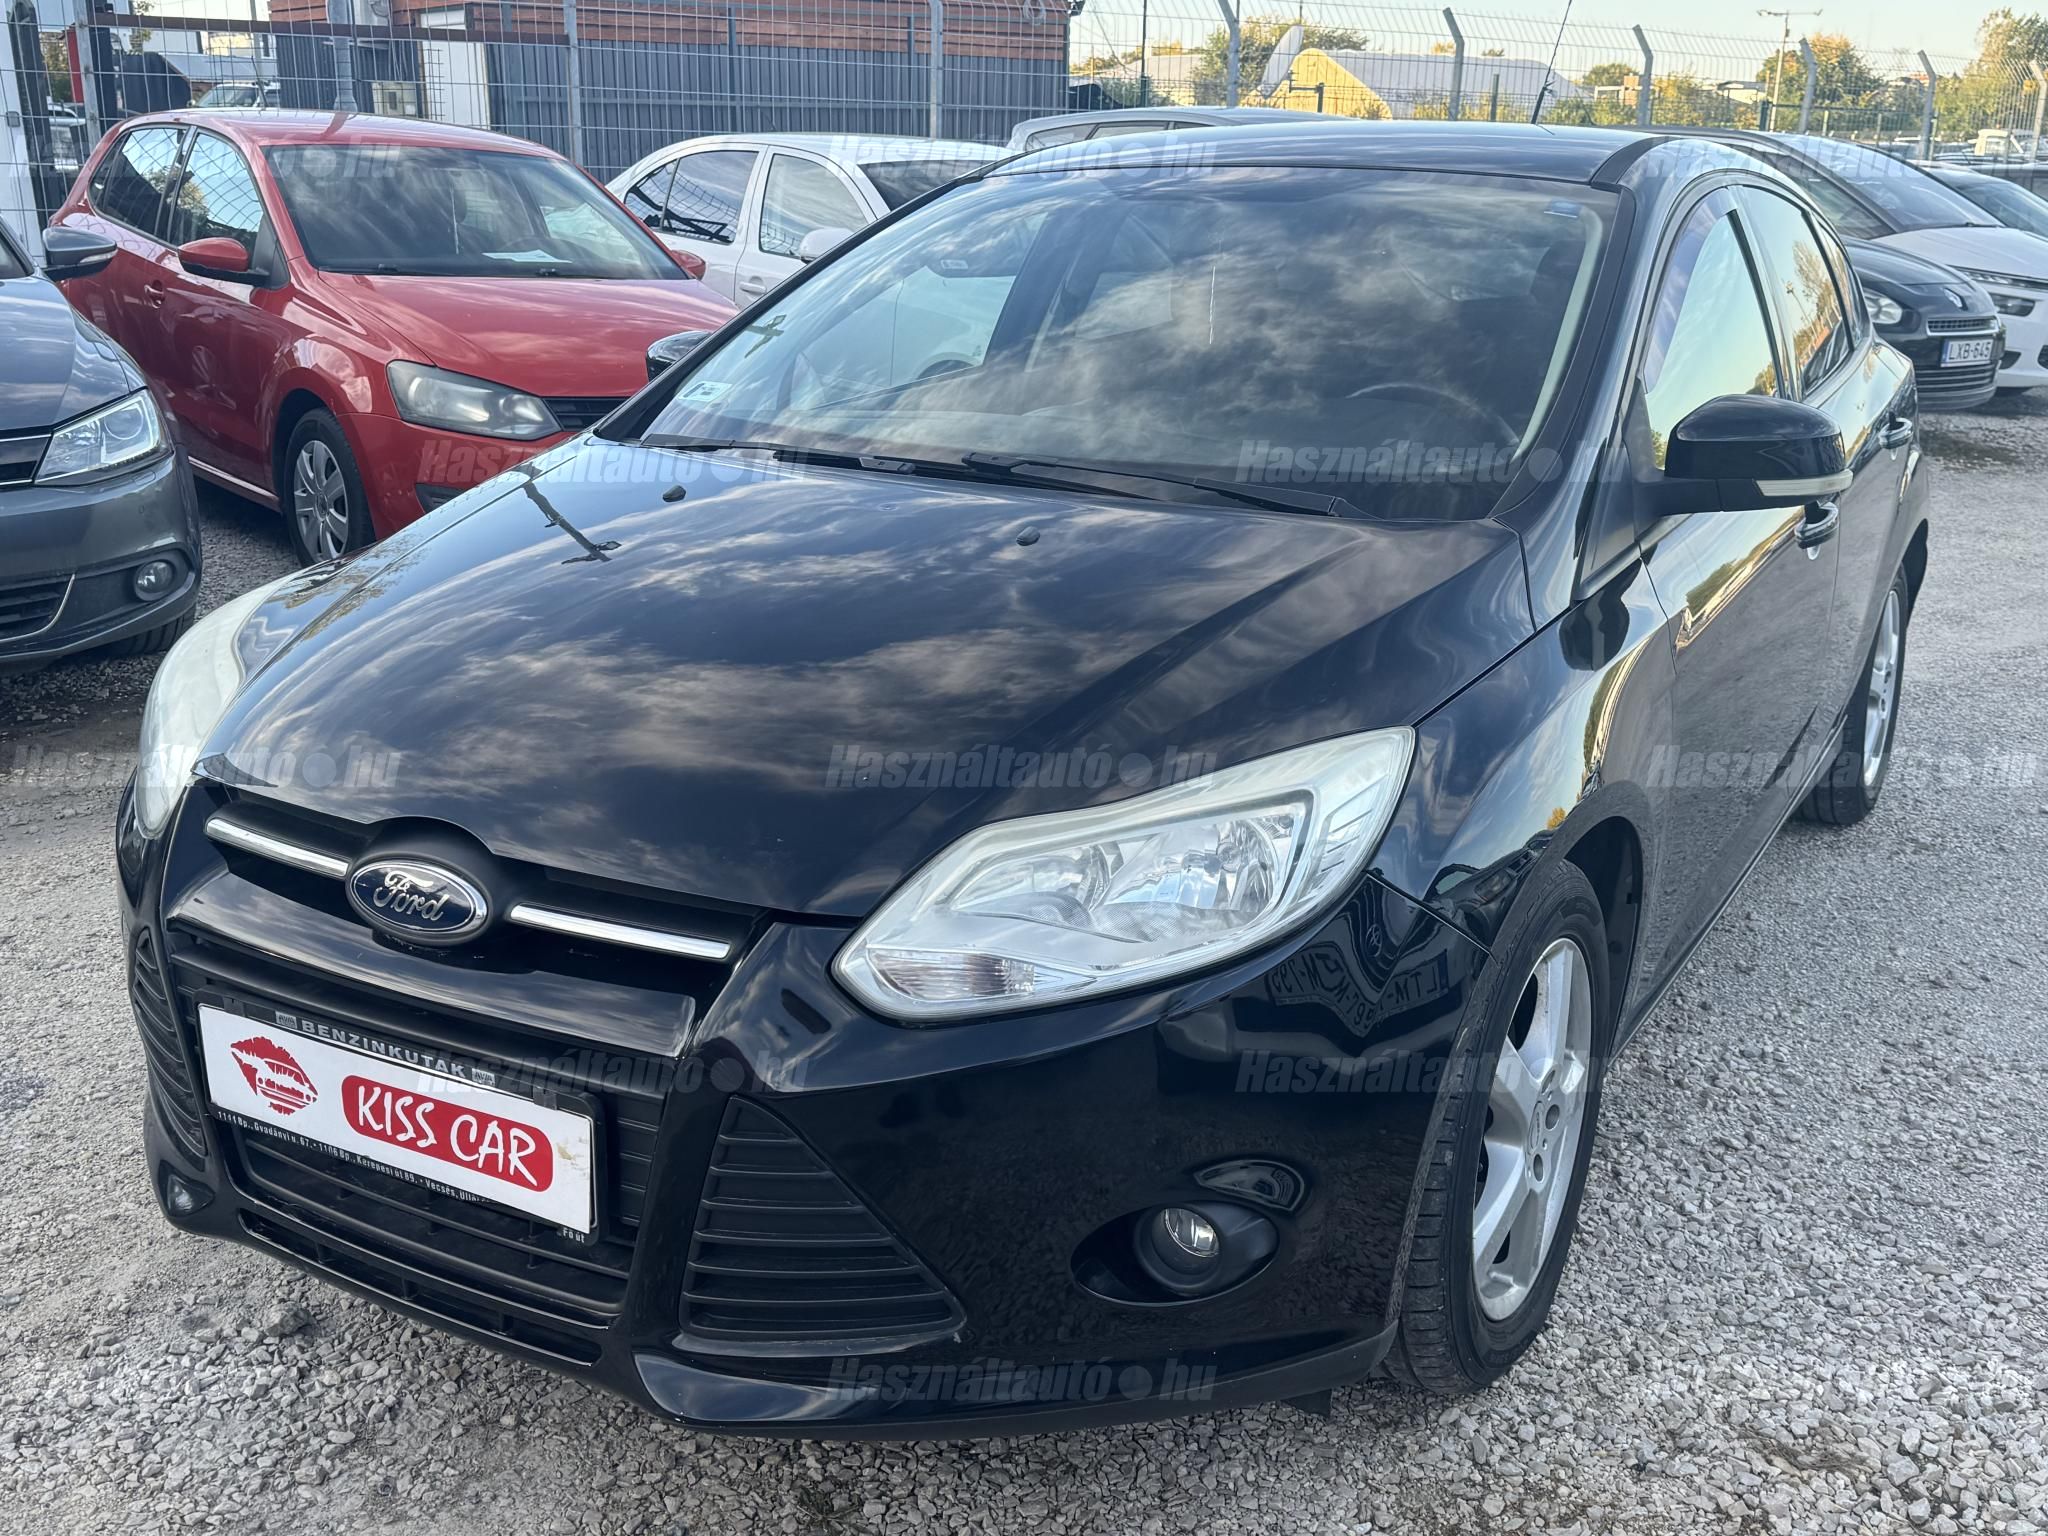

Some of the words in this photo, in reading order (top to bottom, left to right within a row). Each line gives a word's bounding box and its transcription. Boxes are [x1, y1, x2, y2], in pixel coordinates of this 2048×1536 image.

[1949, 341, 1991, 360] LXB-645
[373, 870, 450, 921] Ford
[302, 1020, 465, 1078] BENZINKUTAK
[358, 1085, 437, 1148] KISS
[450, 1114, 538, 1187] CAR
[357, 1155, 394, 1176] Kerepesi
